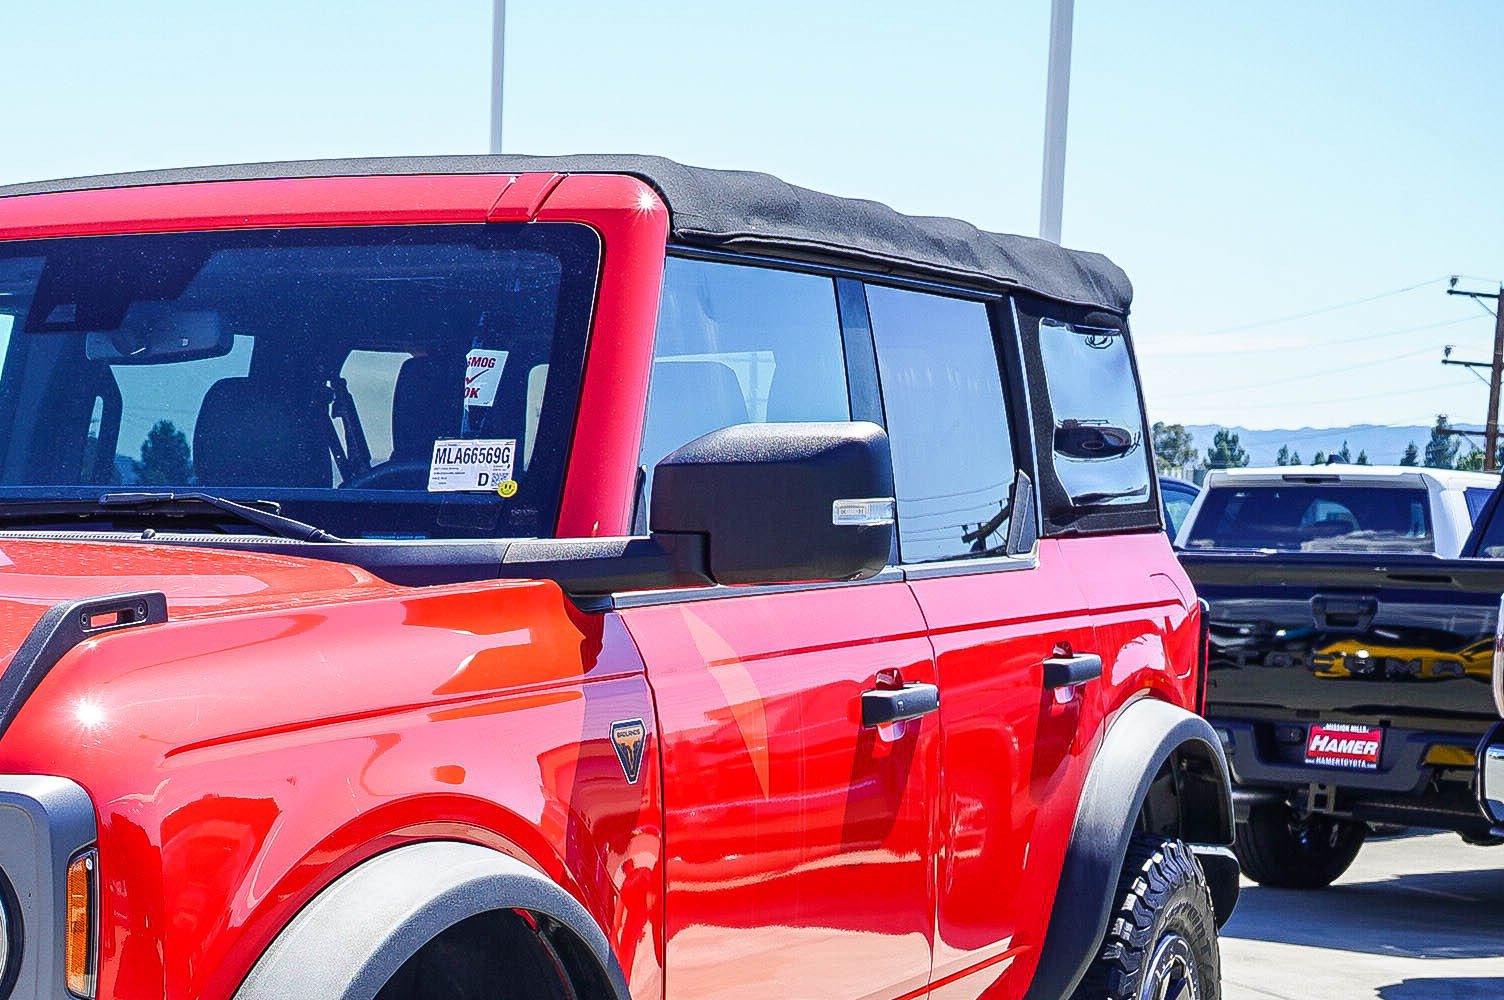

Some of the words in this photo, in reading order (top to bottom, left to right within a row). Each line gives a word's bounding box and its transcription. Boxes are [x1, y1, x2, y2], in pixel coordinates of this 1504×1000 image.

[434, 447, 510, 465] MLA66569G
[478, 473, 489, 486] D
[1309, 734, 1378, 756] HAMER
